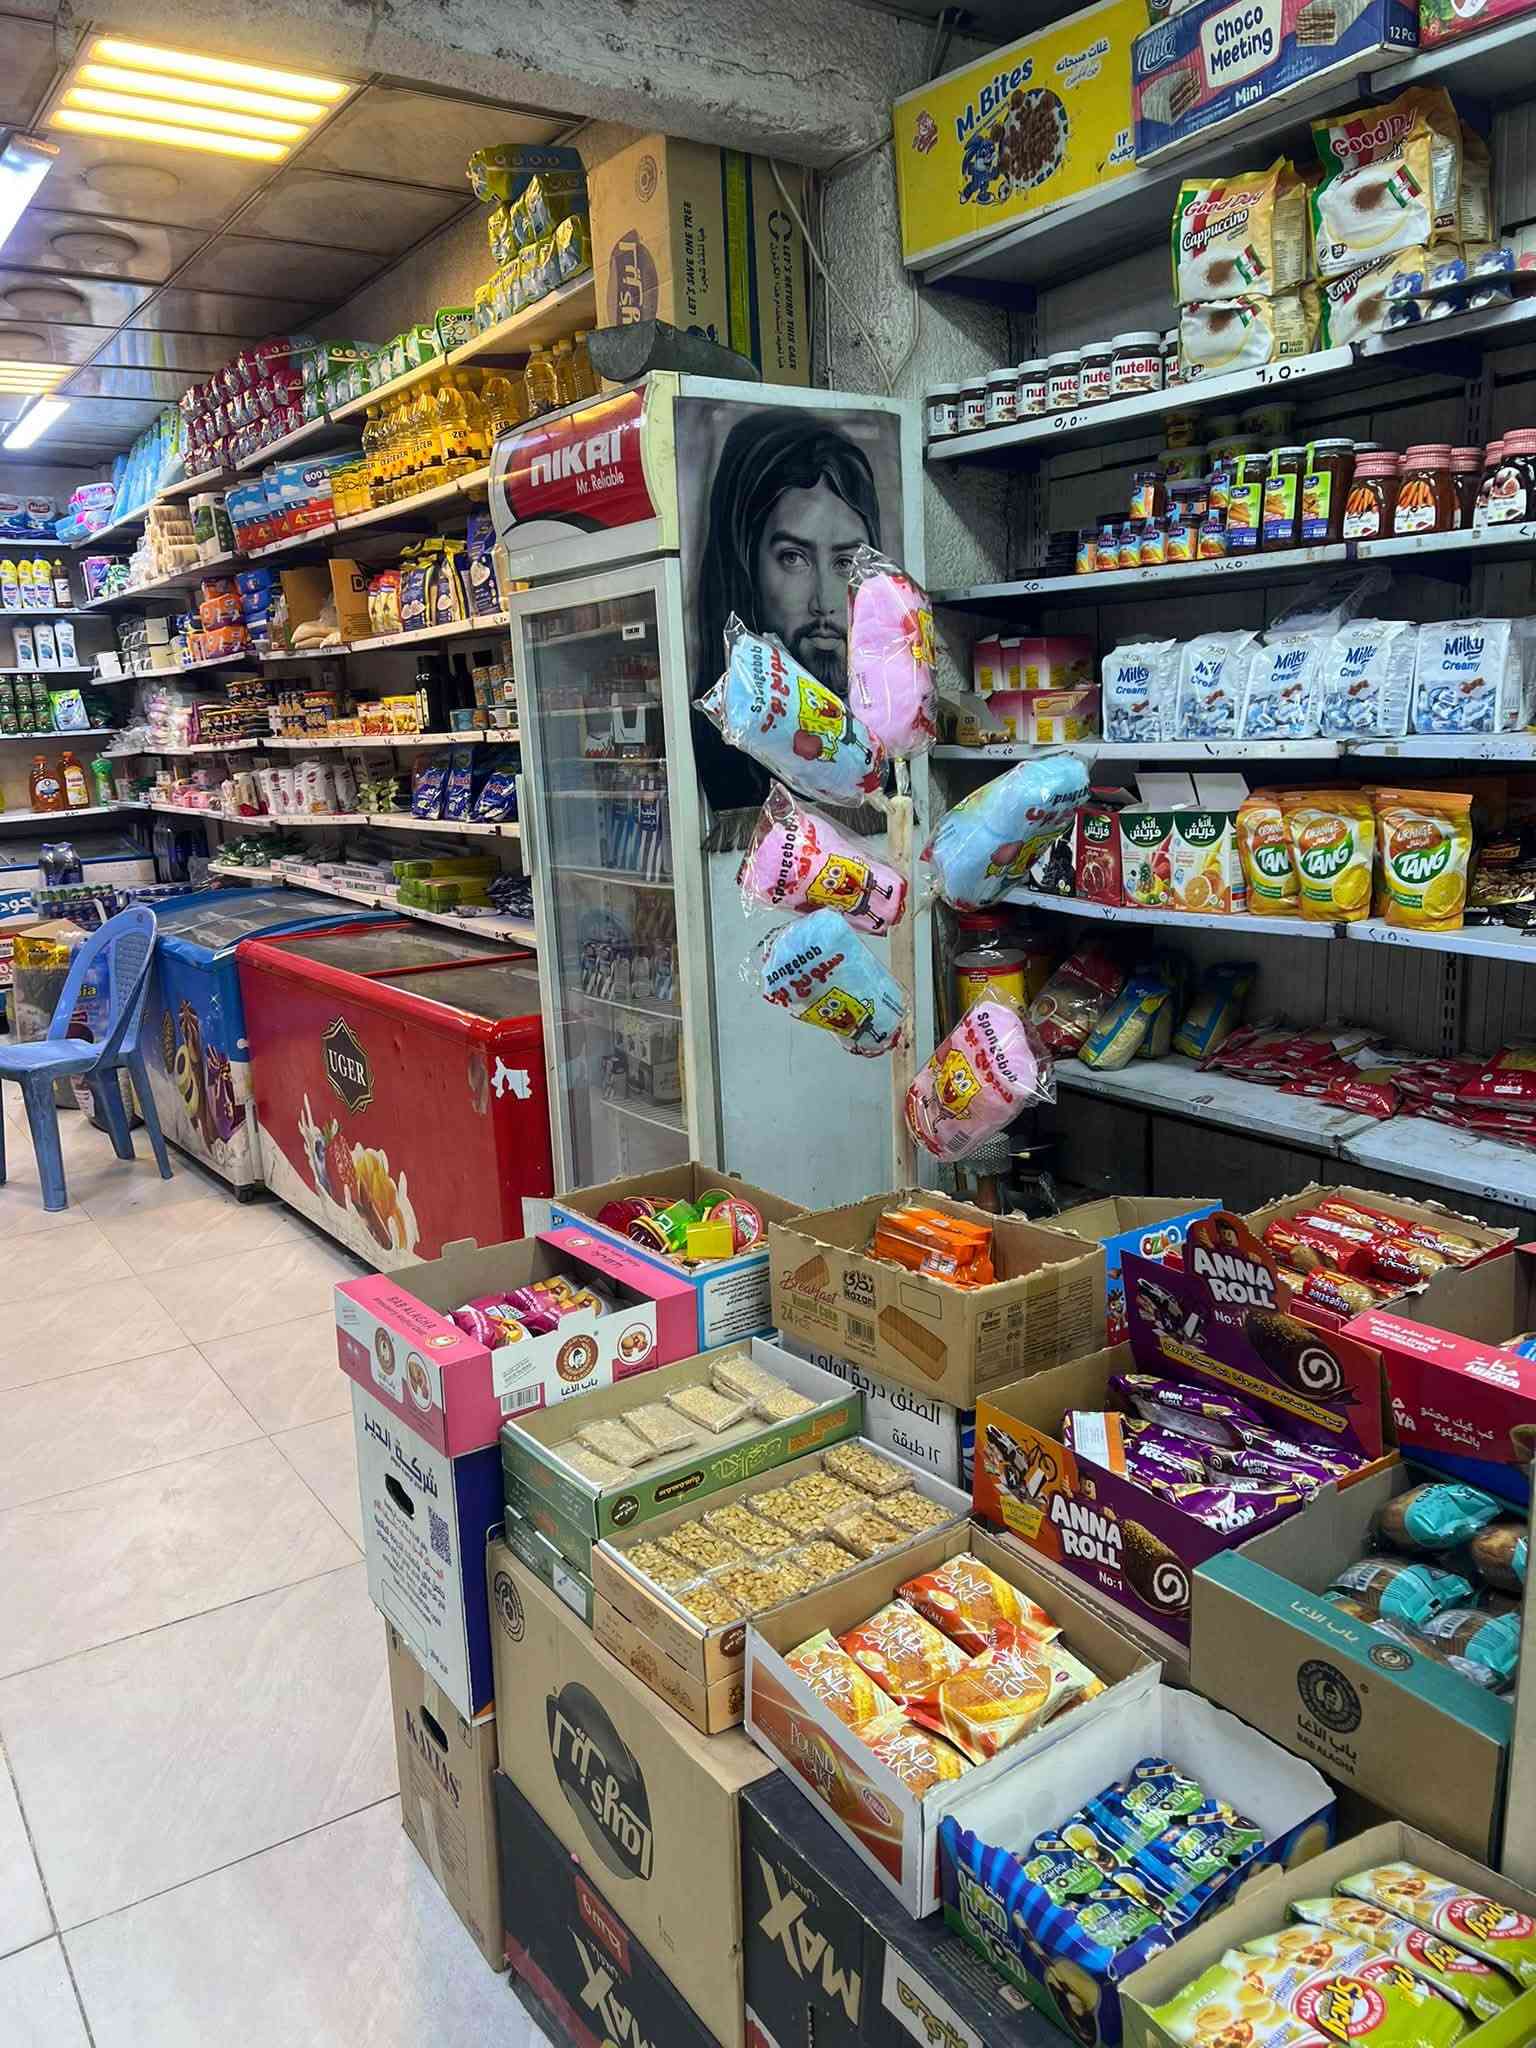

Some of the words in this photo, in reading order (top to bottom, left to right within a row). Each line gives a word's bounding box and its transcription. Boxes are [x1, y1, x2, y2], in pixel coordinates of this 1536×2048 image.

[1214, 5, 1264, 46] Choco
[1389, 26, 1400, 39] 12
[1210, 27, 1273, 75] Meeting
[956, 57, 1033, 142] M.Bites
[1235, 82, 1263, 107] Mini
[683, 201, 692, 229] TREE
[685, 231, 694, 255] ONE
[1183, 210, 1249, 251] Cappuccino
[686, 257, 695, 285] SAVE
[687, 287, 697, 317] LET'S
[784, 275, 794, 317] RETURN
[786, 319, 795, 344] THIS
[1083, 366, 1110, 385] nute
[1115, 357, 1161, 376] nutella
[1026, 382, 1046, 398] nut
[1052, 376, 1079, 394] nute
[997, 393, 1016, 407] nut
[531, 429, 621, 487] NIKAI
[576, 479, 591, 496] Mr.
[592, 468, 625, 491] Reliable
[1444, 636, 1485, 658] Milky
[750, 645, 763, 713] Spongebob
[1117, 666, 1150, 685] Milky
[1442, 660, 1481, 673] Creamy
[1129, 826, 1162, 841] فريش
[1260, 849, 1288, 871] TAN
[1306, 844, 1349, 874] TANG
[1400, 848, 1445, 877] TANG
[328, 1048, 367, 1087] UGER
[1194, 1248, 1274, 1290] ANNA
[780, 1270, 839, 1304] Breakfast
[1208, 1278, 1276, 1309] ROLL
[890, 1388, 940, 1425] الصنف
[892, 1428, 925, 1457] طبقة
[395, 1439, 438, 1498] شركة
[1050, 1495, 1123, 1551] ANNA
[1062, 1530, 1121, 1569] ROLL
[943, 1562, 992, 1596] OUND
[1099, 1571, 1123, 1591] No:1
[1328, 1617, 1359, 1642] باب
[800, 1653, 852, 1692] OUND
[881, 1731, 938, 1769] OUND
[1316, 1974, 1364, 2042] Spicy
